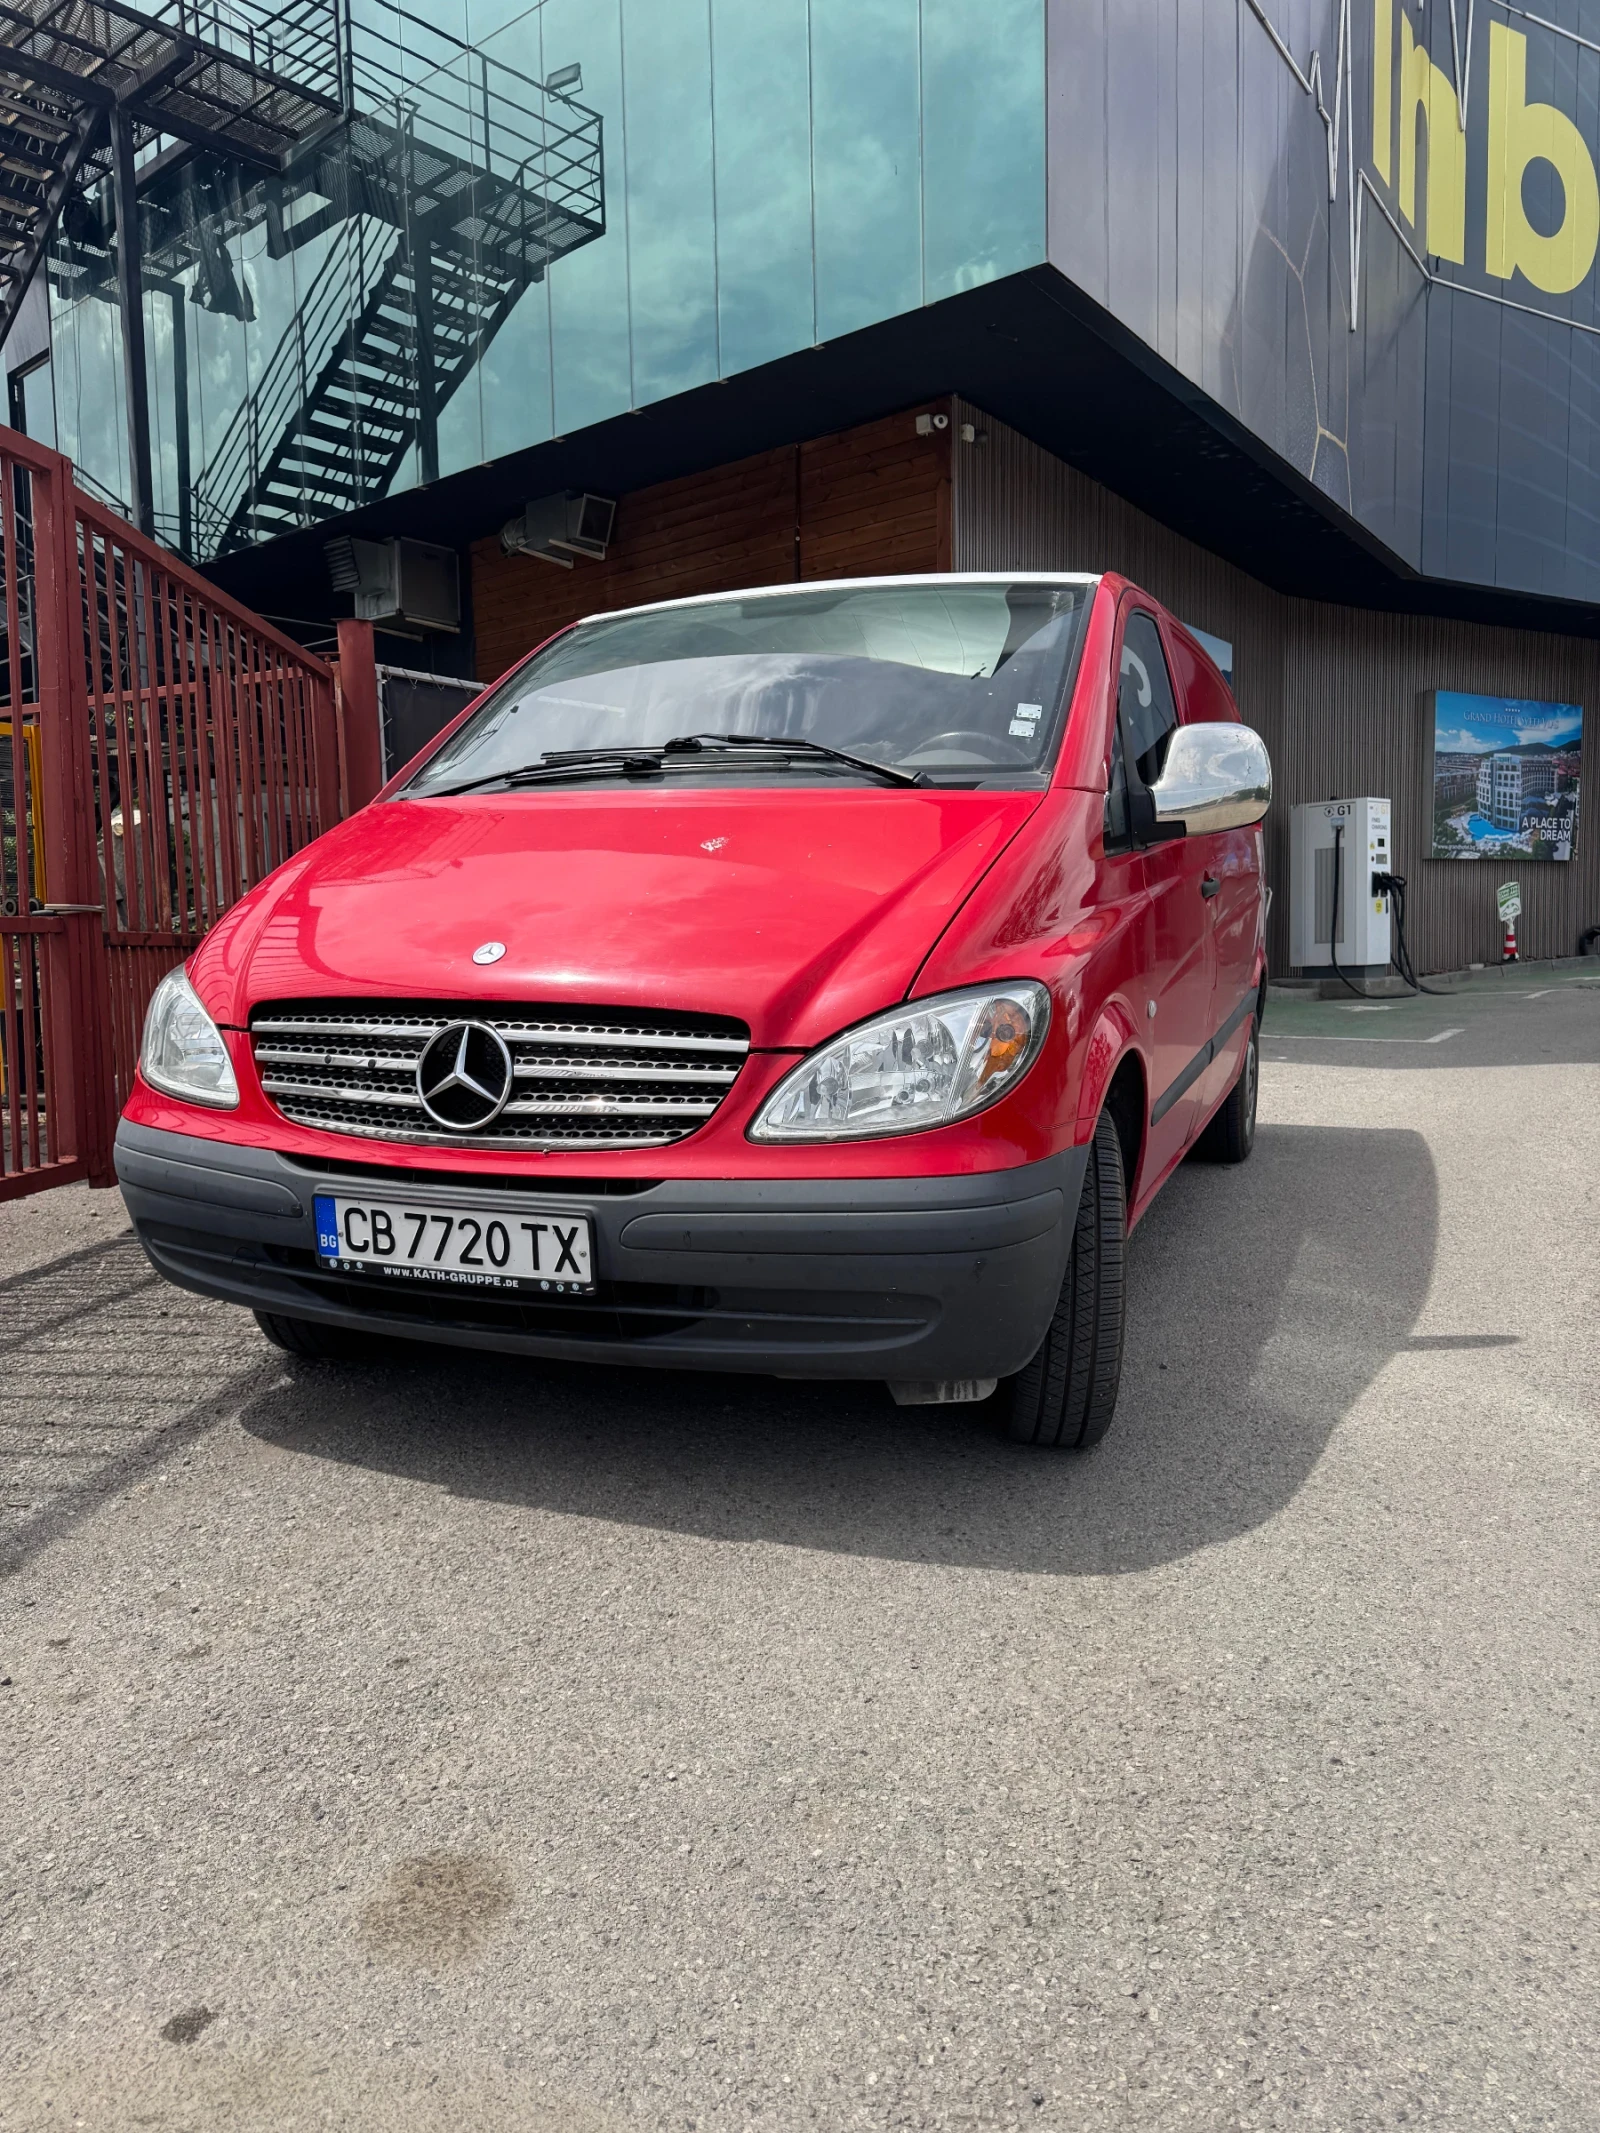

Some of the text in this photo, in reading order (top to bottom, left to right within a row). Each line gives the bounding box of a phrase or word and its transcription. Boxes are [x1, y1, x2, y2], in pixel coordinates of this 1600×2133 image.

[1463, 709, 1492, 722] GRAND
[1337, 804, 1351, 816] G1
[1522, 817, 1571, 829] A PLACE TO
[1540, 830, 1571, 841] DREAM
[320, 1234, 337, 1248] BG
[343, 1207, 581, 1274] CB 7720 TX
